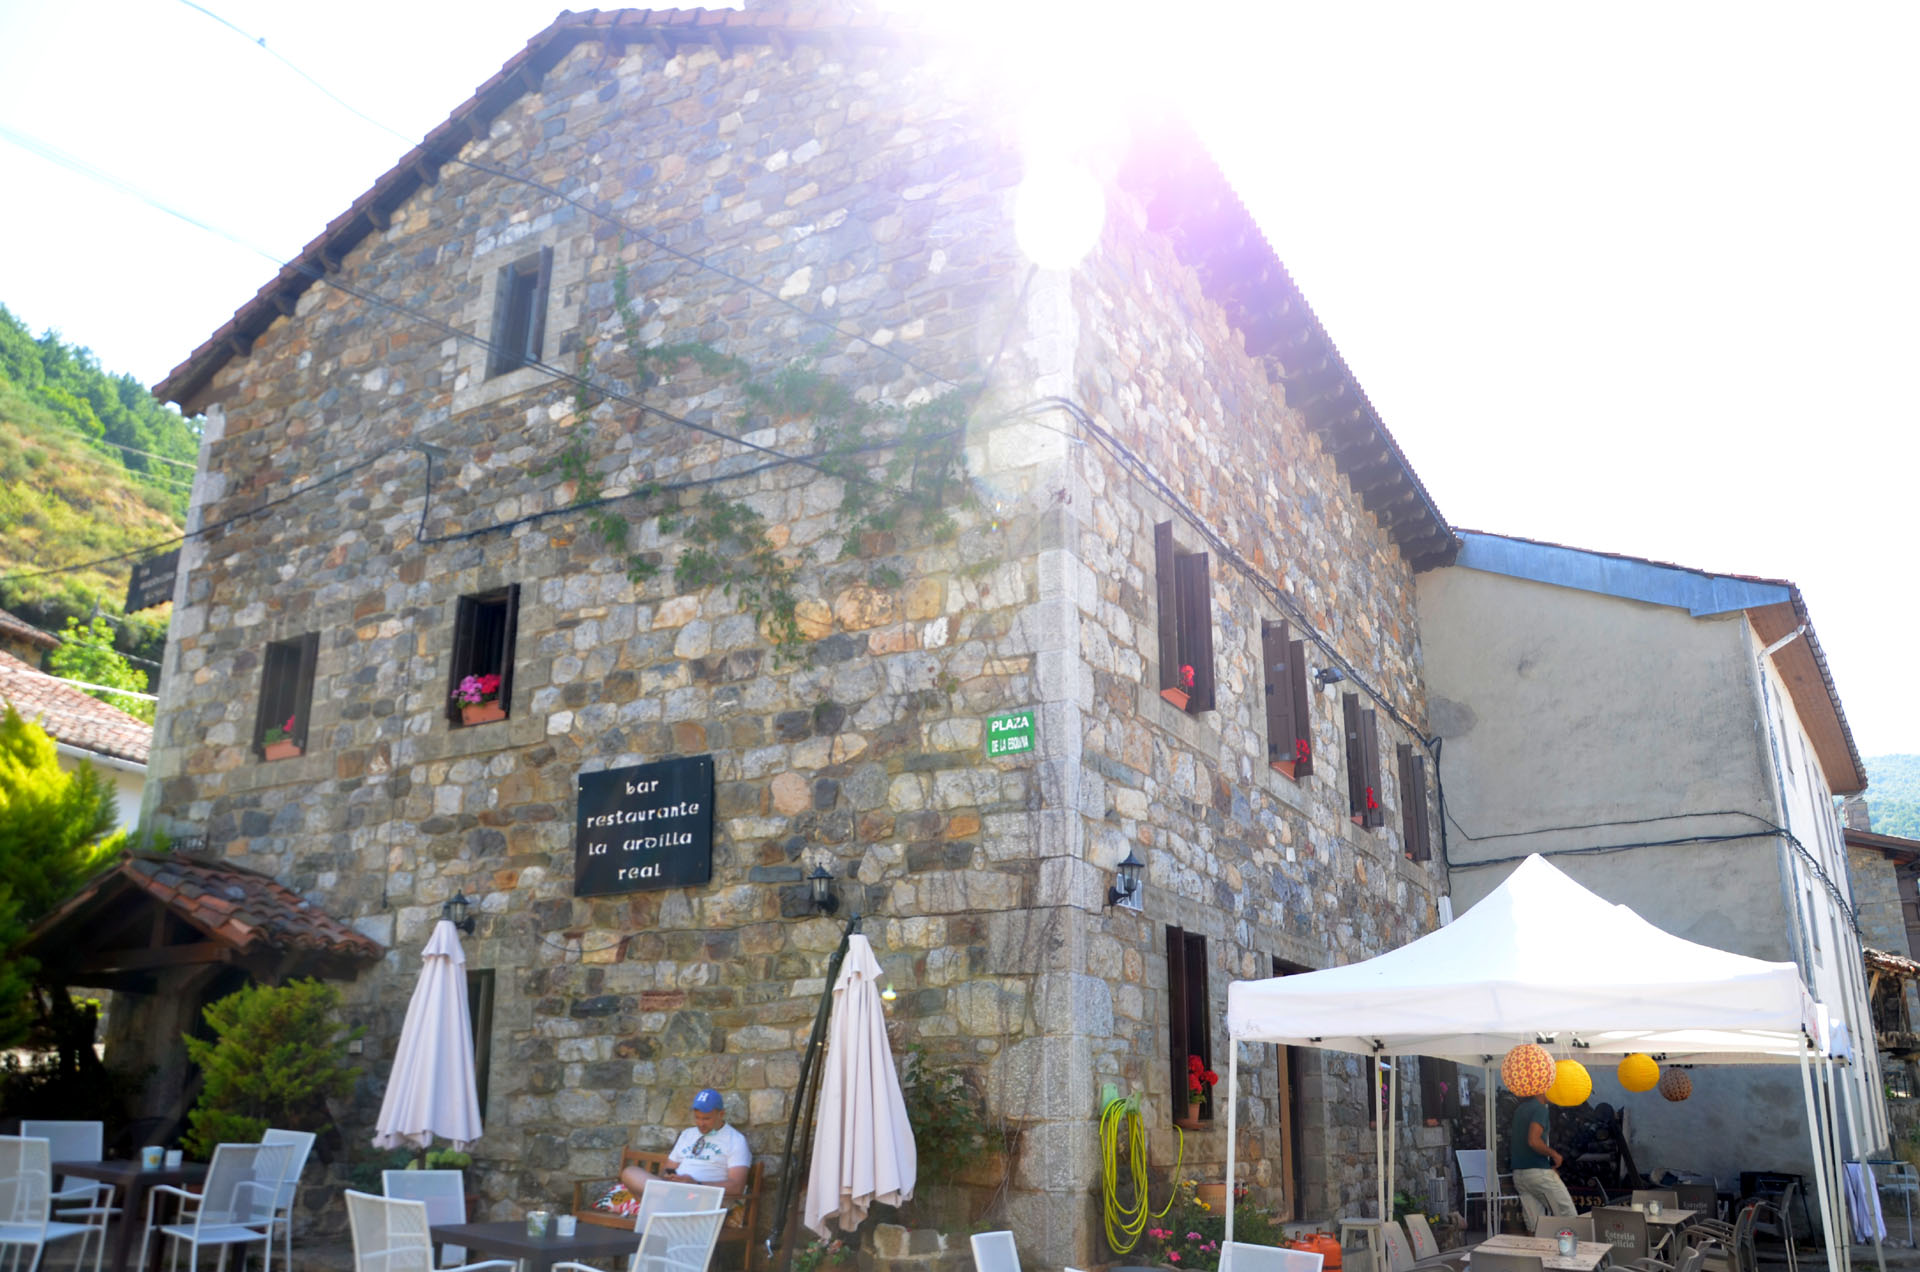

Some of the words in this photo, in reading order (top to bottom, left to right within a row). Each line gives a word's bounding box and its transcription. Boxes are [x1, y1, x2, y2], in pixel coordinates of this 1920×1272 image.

[991, 716, 1029, 732] PLAZA
[626, 780, 659, 795] bar
[587, 801, 699, 828] restaurante
[589, 843, 607, 856] la
[618, 863, 662, 881] real
[697, 1091, 709, 1102] H
